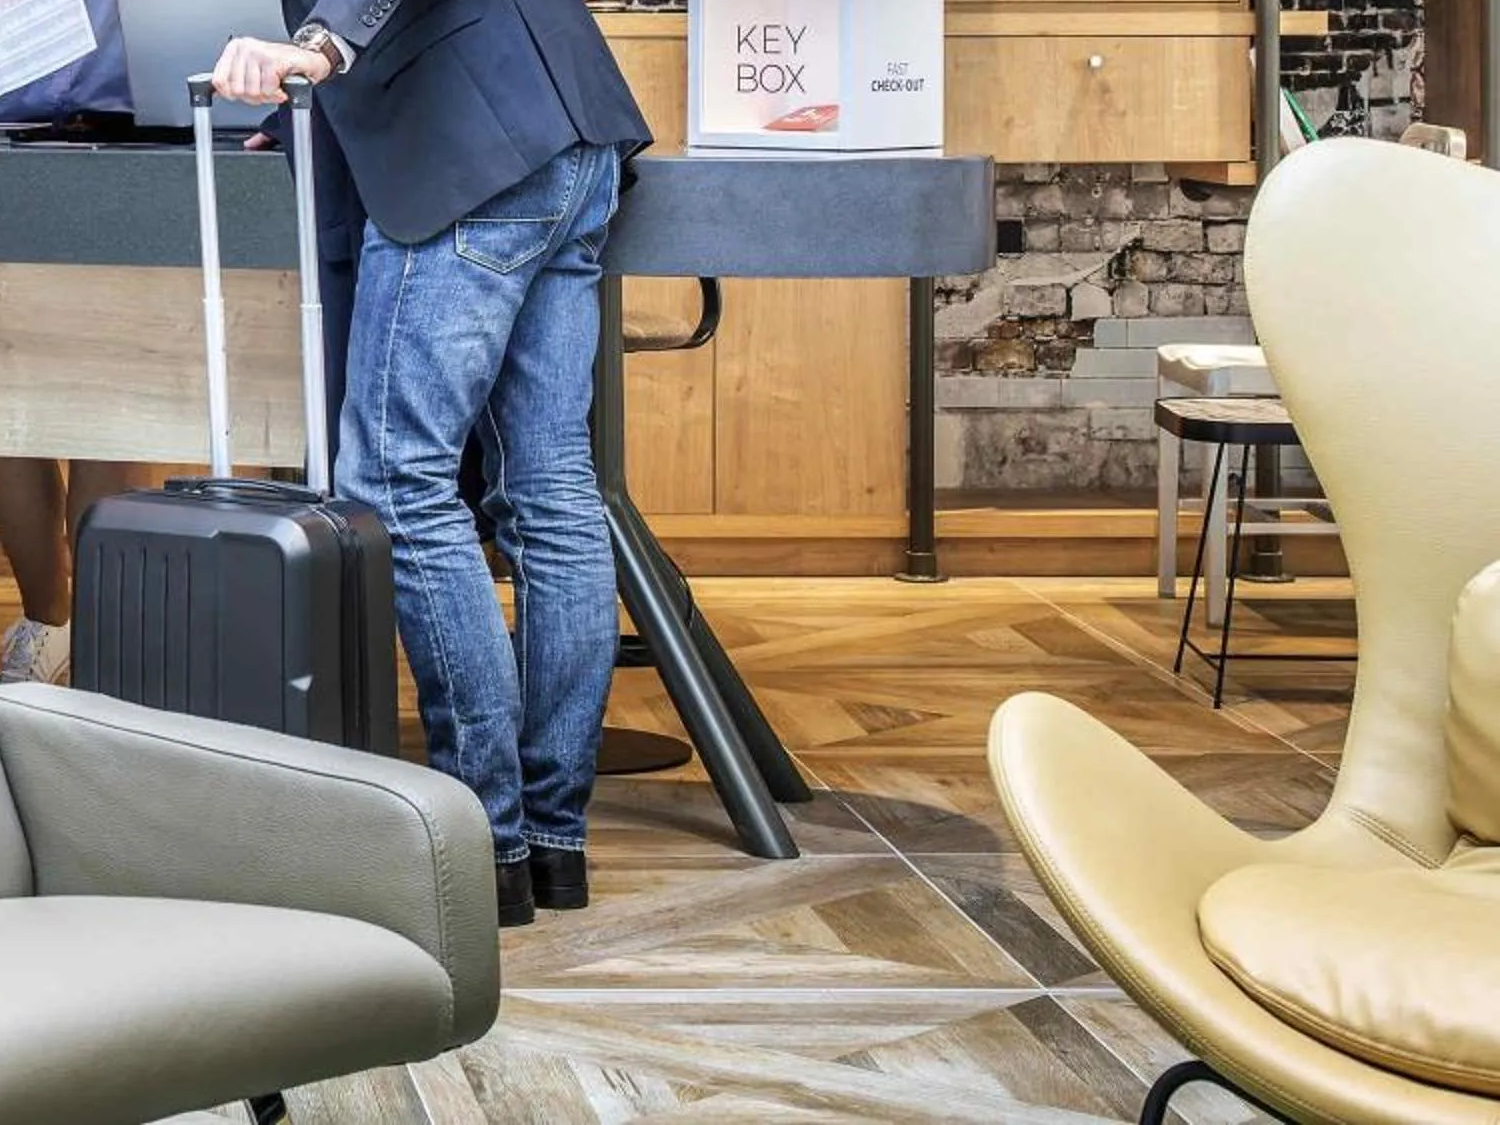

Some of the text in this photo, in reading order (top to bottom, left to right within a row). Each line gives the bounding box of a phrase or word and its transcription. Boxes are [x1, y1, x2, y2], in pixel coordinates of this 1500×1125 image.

[736, 24, 807, 54] KEY
[736, 64, 806, 93] BOX
[887, 62, 909, 75] FAST
[871, 78, 925, 92] CHECK-OUT
